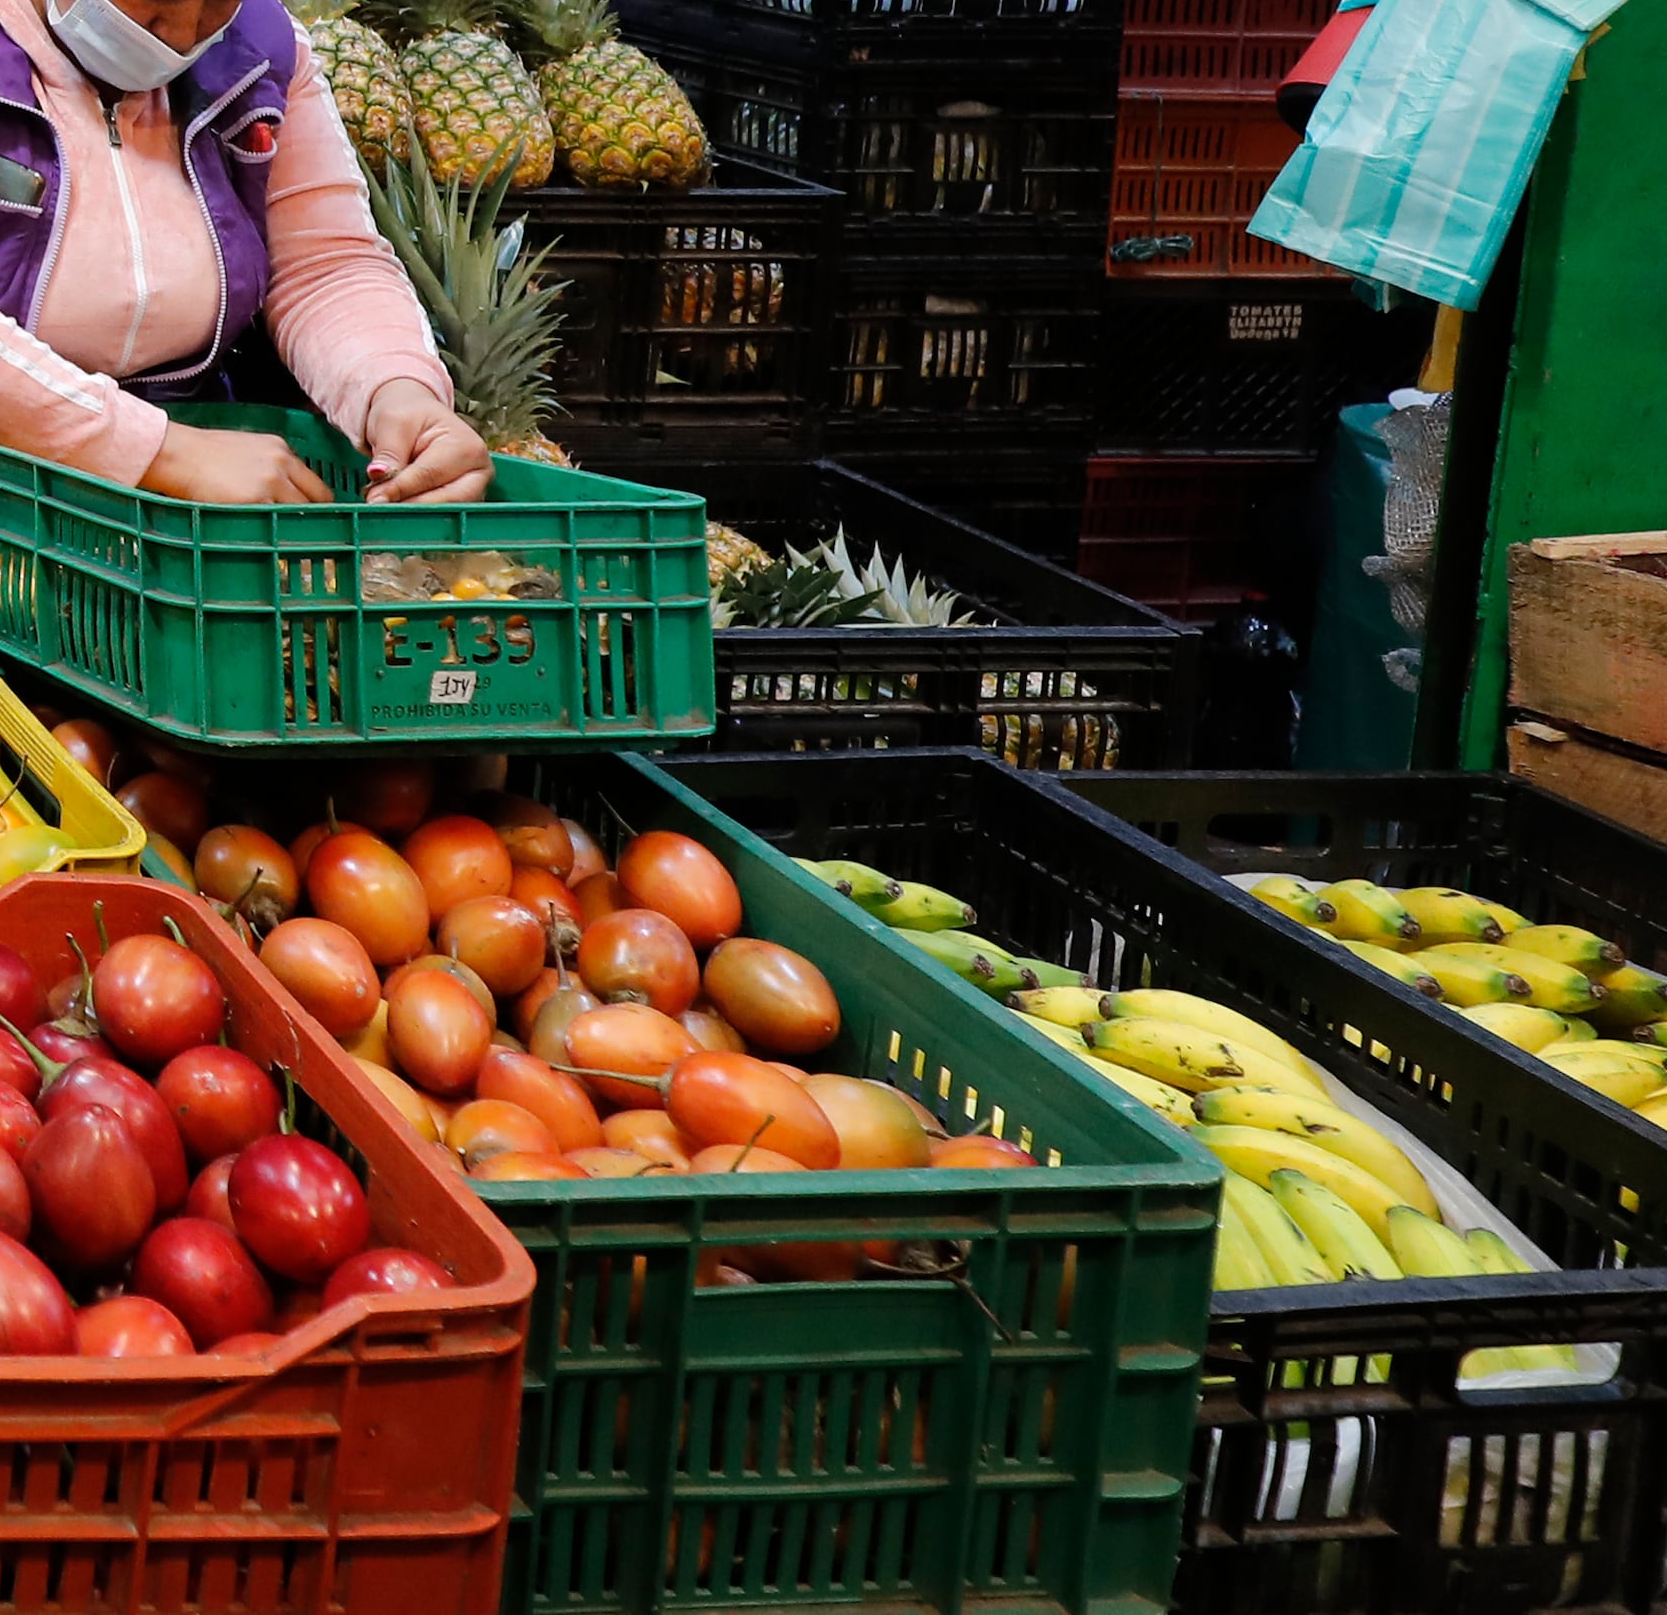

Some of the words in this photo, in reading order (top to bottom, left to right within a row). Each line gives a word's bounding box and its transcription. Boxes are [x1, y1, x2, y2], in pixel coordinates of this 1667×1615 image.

[1229, 304, 1303, 316] TOMATES
[1228, 316, 1303, 328] ELIZABETH
[381, 615, 536, 667] E-139
[370, 703, 466, 719] PROHIBIDA
[469, 703, 492, 717] SU
[497, 703, 552, 718] VENTA
